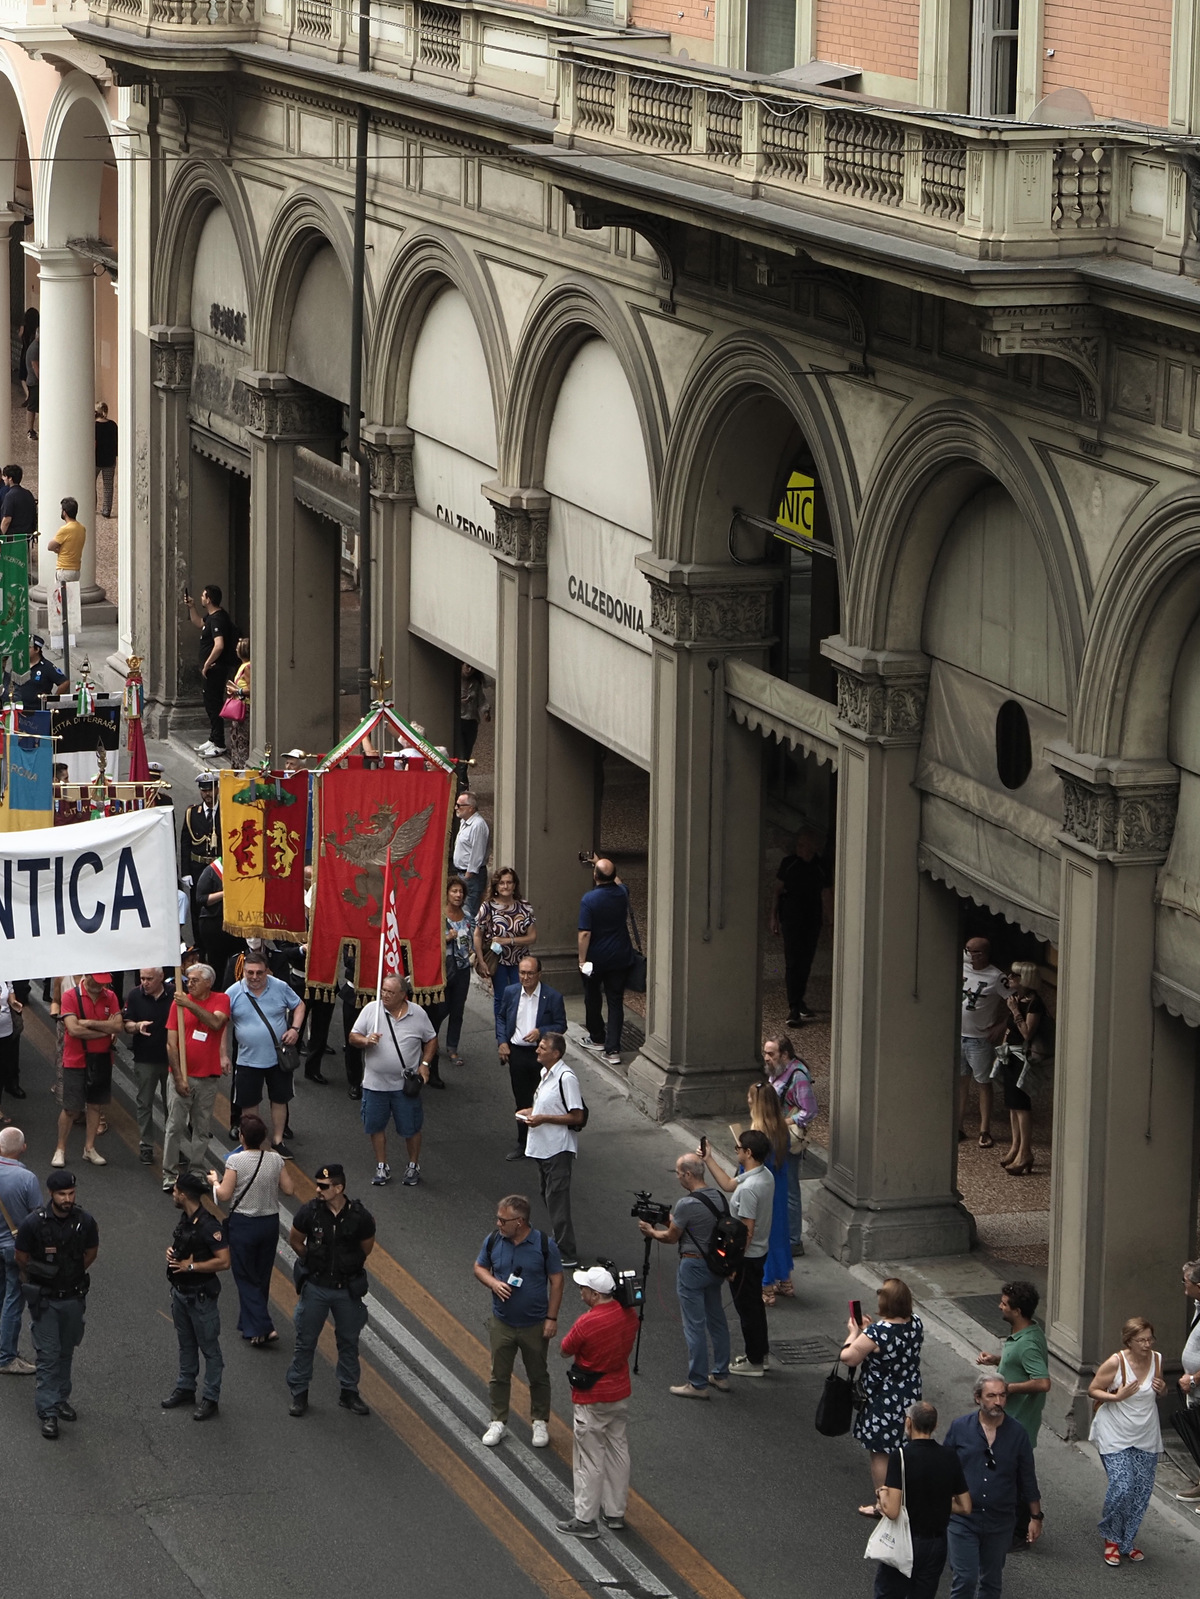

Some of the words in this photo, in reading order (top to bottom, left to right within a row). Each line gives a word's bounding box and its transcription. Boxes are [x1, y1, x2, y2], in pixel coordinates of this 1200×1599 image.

[777, 490, 813, 530] NIC
[568, 575, 645, 635] CALZEDONIA
[52, 719, 72, 735] CITTA
[83, 716, 117, 732] FERRARA
[236, 910, 288, 926] RAVENNA
